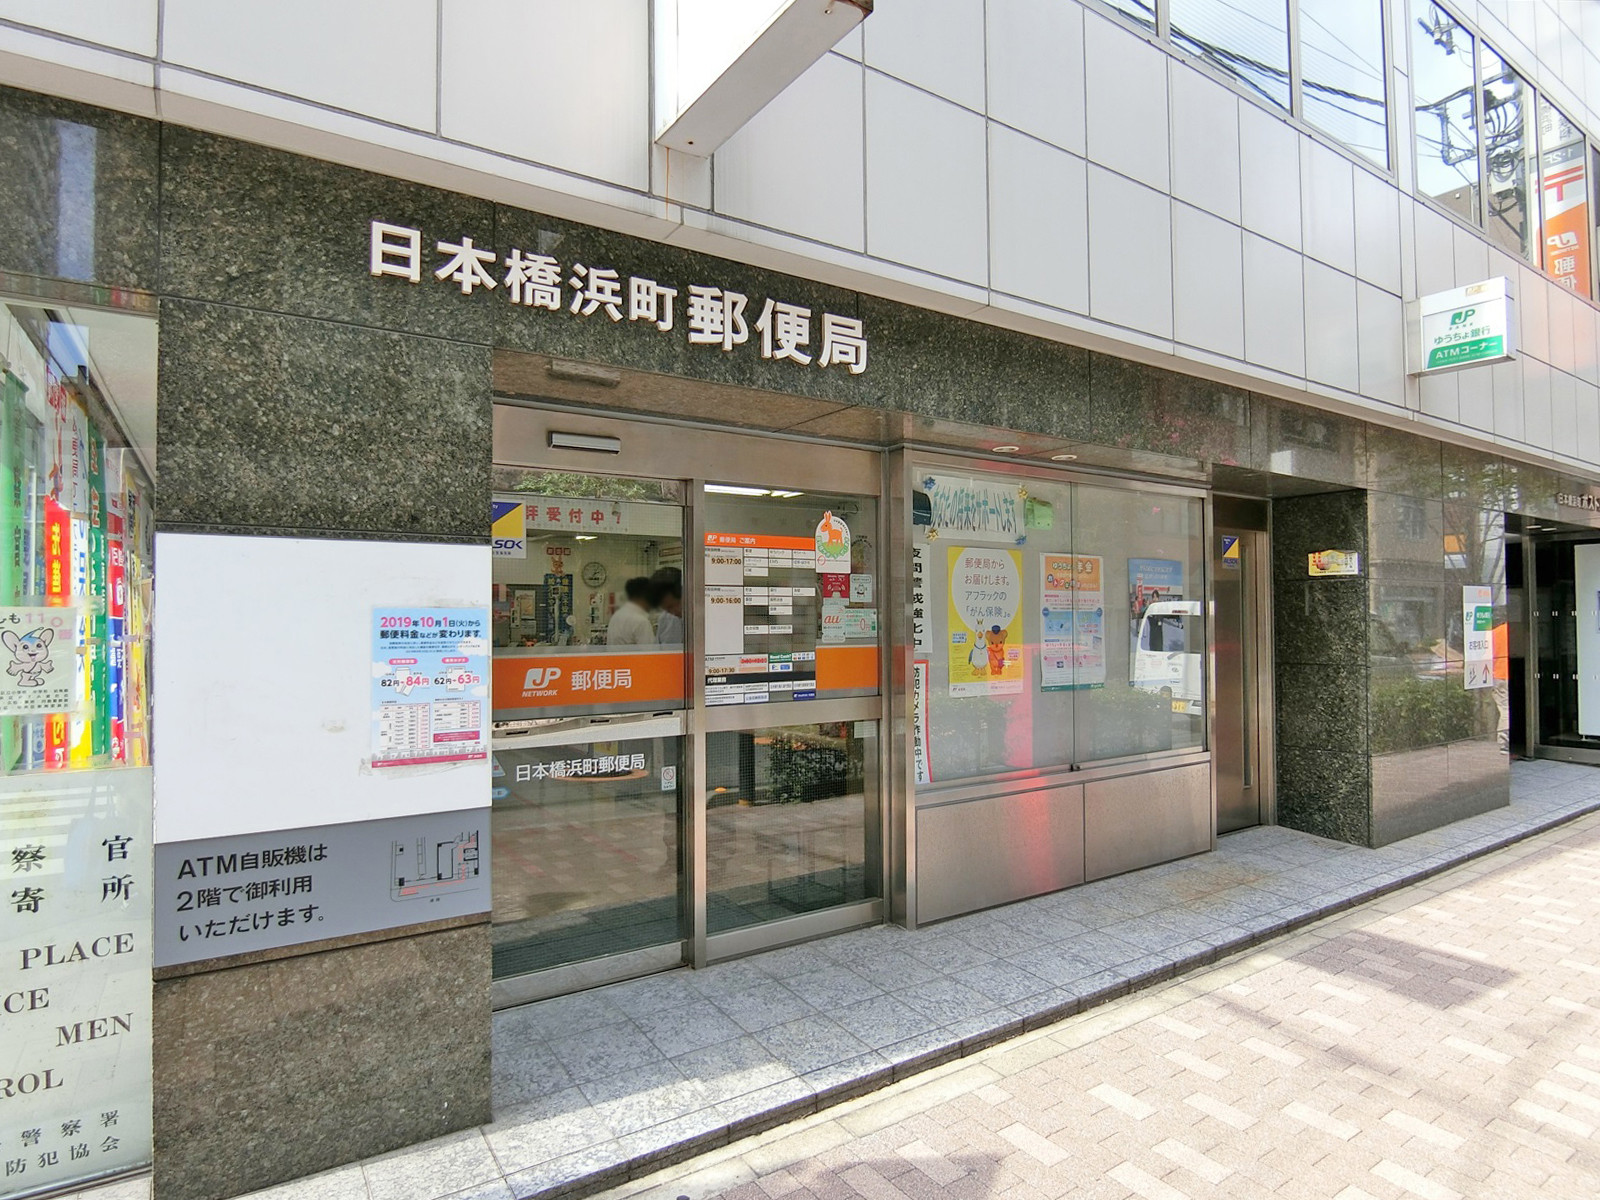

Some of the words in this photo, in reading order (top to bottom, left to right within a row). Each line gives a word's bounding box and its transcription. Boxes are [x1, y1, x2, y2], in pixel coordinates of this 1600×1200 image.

[369, 220, 869, 375] 日本橋浜町郵便局
[1451, 309, 1476, 325] JP
[1433, 325, 1491, 345] ゆうちょ銀行
[1435, 341, 1498, 359] ATMコーナー
[492, 539, 523, 549] SOK
[964, 557, 1005, 570] 郵便局から
[964, 574, 1010, 586] お届けします。
[965, 590, 1007, 601] アフラックの
[965, 605, 1011, 618] 「がん保険」。
[380, 629, 482, 639] 郵便料金などが変わります。
[381, 679, 399, 687] 82円
[406, 676, 429, 687] 84円
[434, 677, 452, 685] 62円
[457, 674, 480, 684] 63円
[523, 667, 562, 690] JP
[571, 668, 632, 691] 郵便局
[522, 690, 558, 698] NETWORK
[516, 753, 646, 783] 日本橋浜町郵便局
[177, 842, 329, 880] ATM自販機は
[176, 874, 313, 912] 2階で御利用
[179, 903, 325, 942] いただけます。
[20, 932, 135, 971] PLACE
[0, 987, 50, 1015] CE
[56, 1012, 134, 1047] MEN
[5, 1135, 120, 1177] 防犯協会
